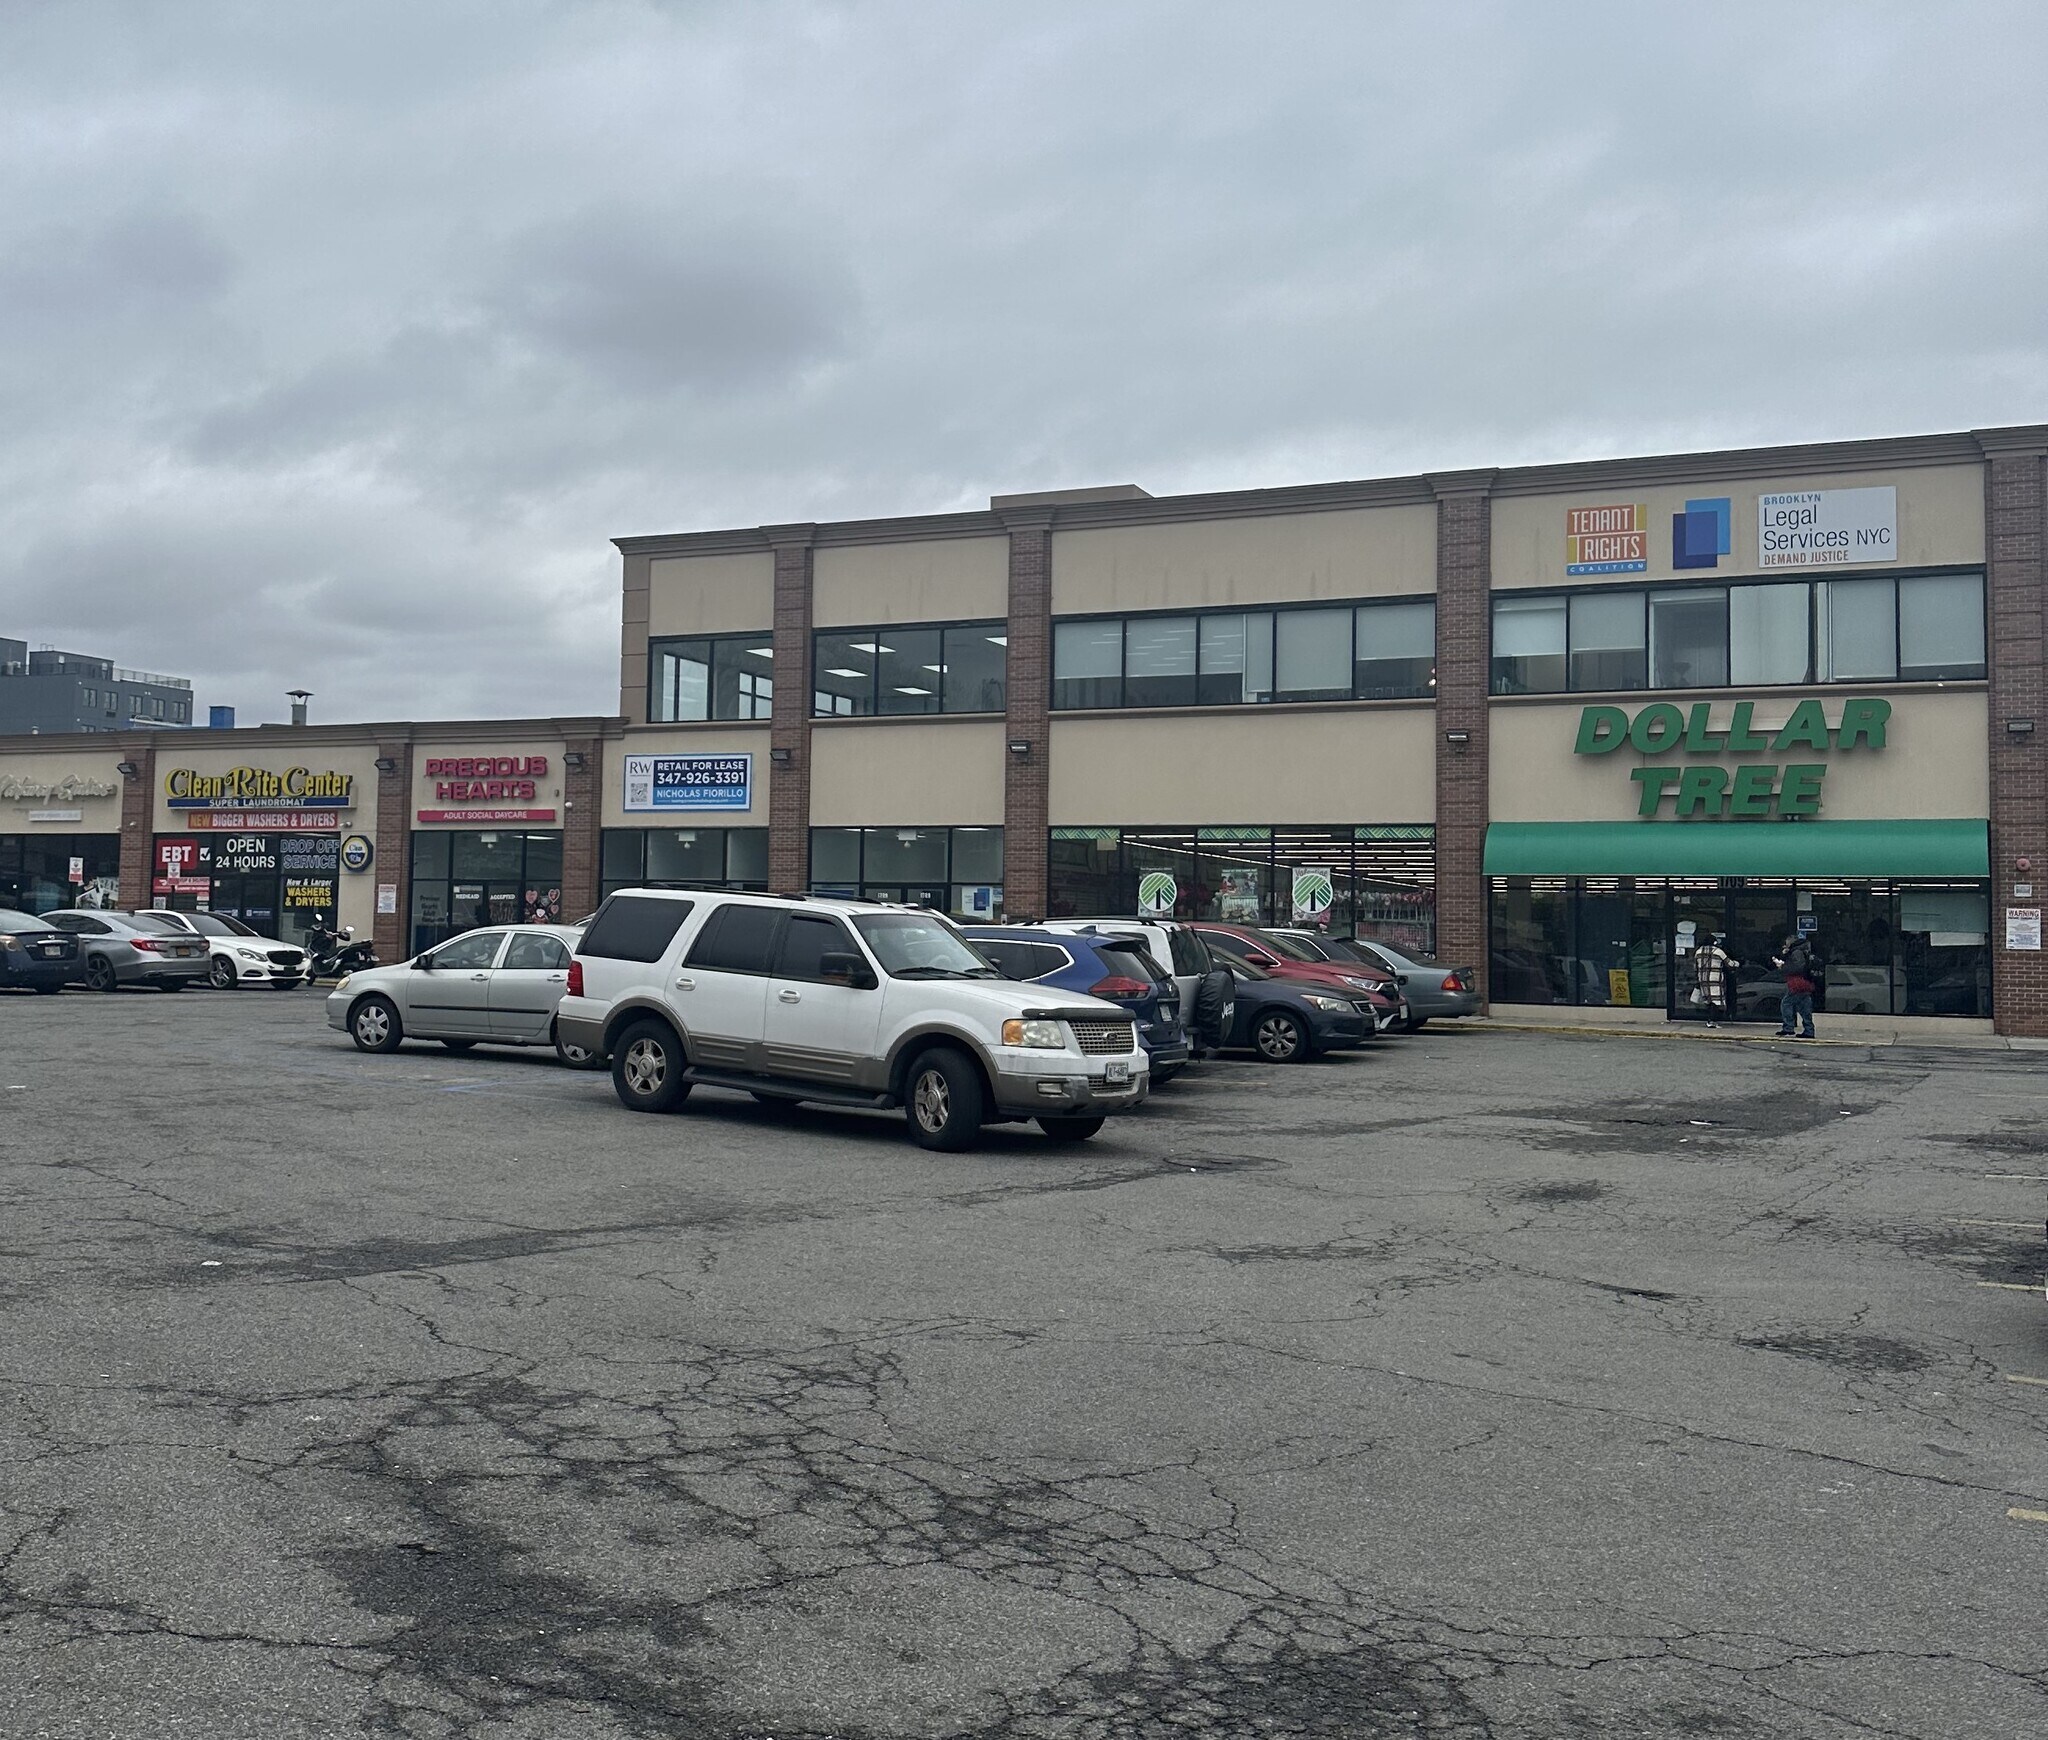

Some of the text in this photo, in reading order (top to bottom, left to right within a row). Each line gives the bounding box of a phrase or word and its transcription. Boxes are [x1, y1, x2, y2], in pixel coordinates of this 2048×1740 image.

[1764, 493, 1821, 505] BROOKLYN
[1571, 508, 1630, 533] TENANT
[1764, 504, 1817, 530] Legal
[1764, 527, 1891, 550] Services NYC
[1584, 536, 1640, 561] RIGHTS
[1764, 550, 1849, 565] DEMAND JUSTICE
[1570, 563, 1644, 572] COALITION
[1574, 698, 1892, 754] DOLLAR
[425, 757, 547, 776] PRECIOUS
[630, 761, 652, 774] RW
[657, 761, 745, 771] RETAIL FOR LEASE
[164, 766, 352, 797] Clean Rite Center
[657, 772, 744, 784] 347-926-3391
[436, 780, 536, 799] HEARTS
[656, 788, 744, 798] NICHOLAS FIORILLO
[1630, 764, 1827, 815] TREE
[209, 798, 306, 807] SUPER LAUNDROMAT
[190, 813, 335, 826] NEW BIGGER WASHERS & DRYERS
[467, 811, 493, 819] SOCIAL
[226, 838, 265, 853] OPEN
[280, 839, 340, 853] DROP OFF
[162, 846, 192, 862] EBT
[216, 856, 276, 868] 24 HOURS
[283, 855, 337, 869] SERVICE
[286, 878, 300, 887] New
[287, 887, 331, 896] WASHERS
[285, 897, 332, 906] & DRYERS
